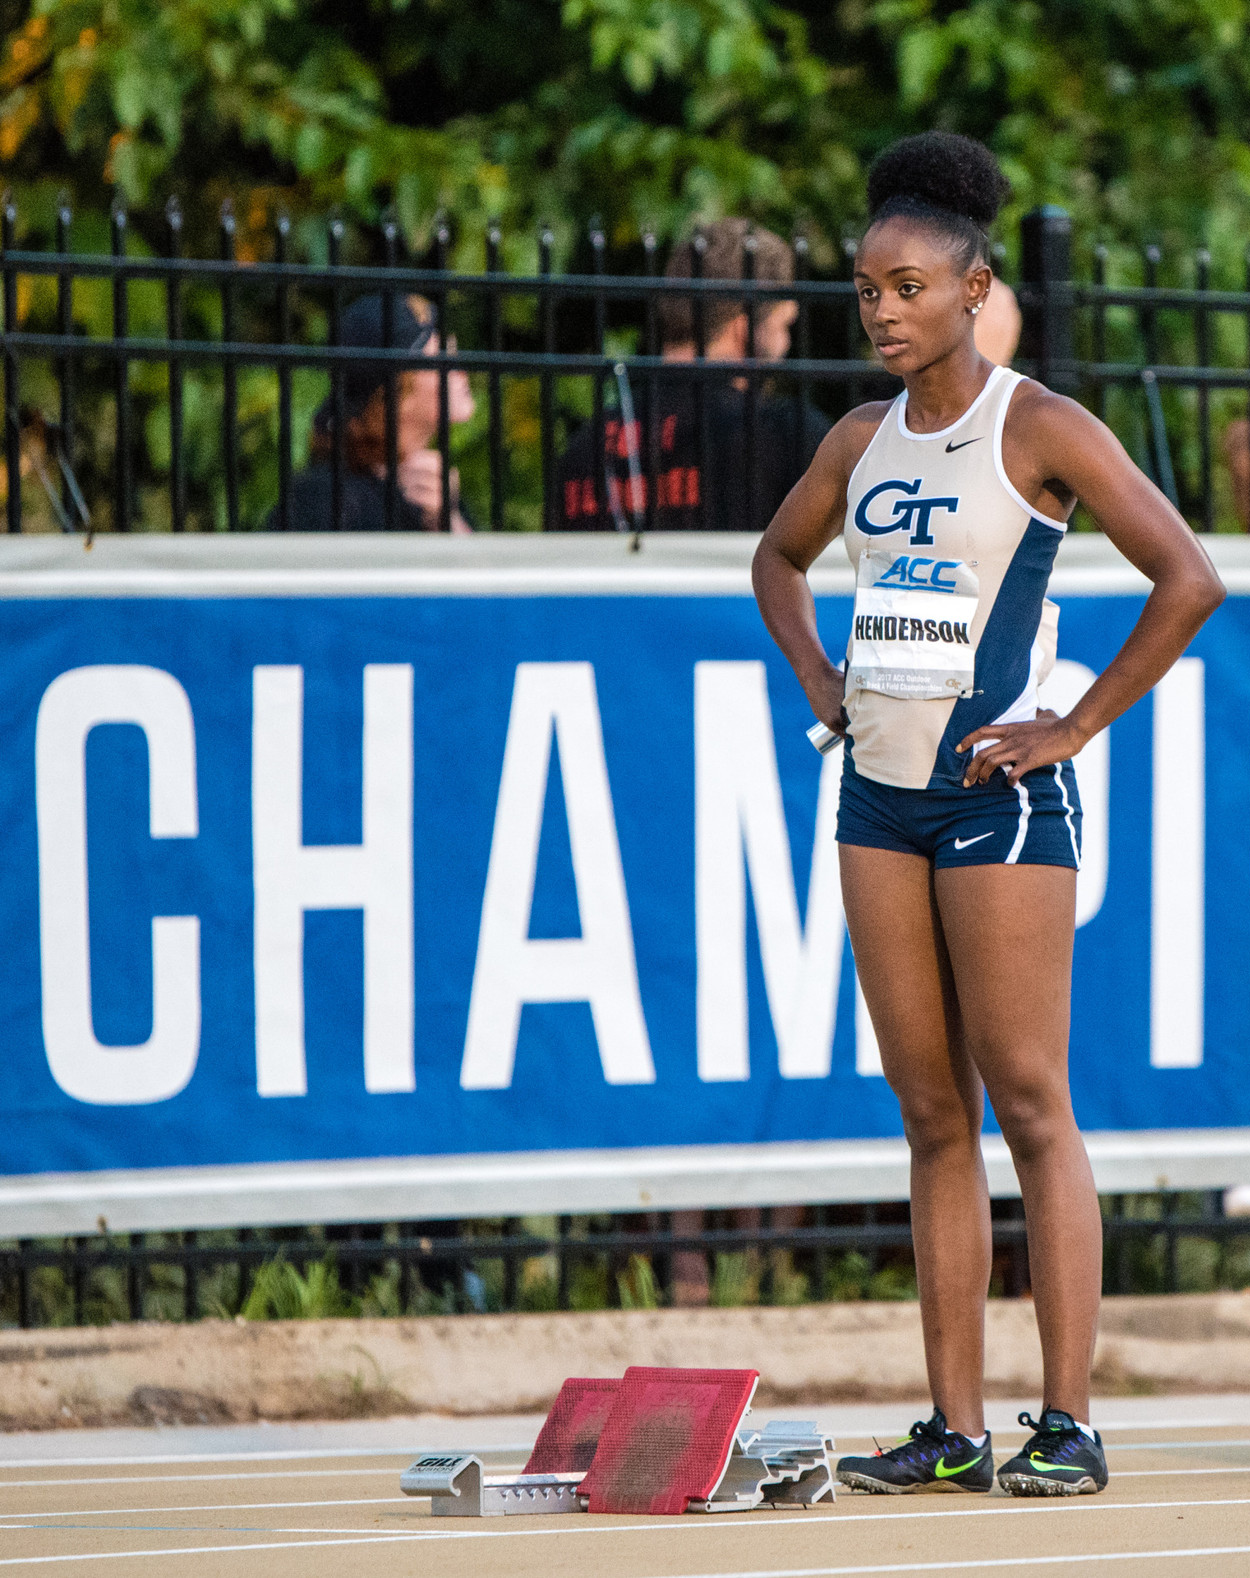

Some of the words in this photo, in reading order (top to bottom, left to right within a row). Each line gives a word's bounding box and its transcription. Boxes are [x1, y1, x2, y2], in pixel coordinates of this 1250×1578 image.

[853, 477, 961, 547] GT
[879, 556, 963, 588] ACC
[855, 615, 970, 645] HENDERSON
[877, 674, 891, 682] 2017
[893, 674, 905, 682] ACC
[906, 675, 931, 683] Outdoor
